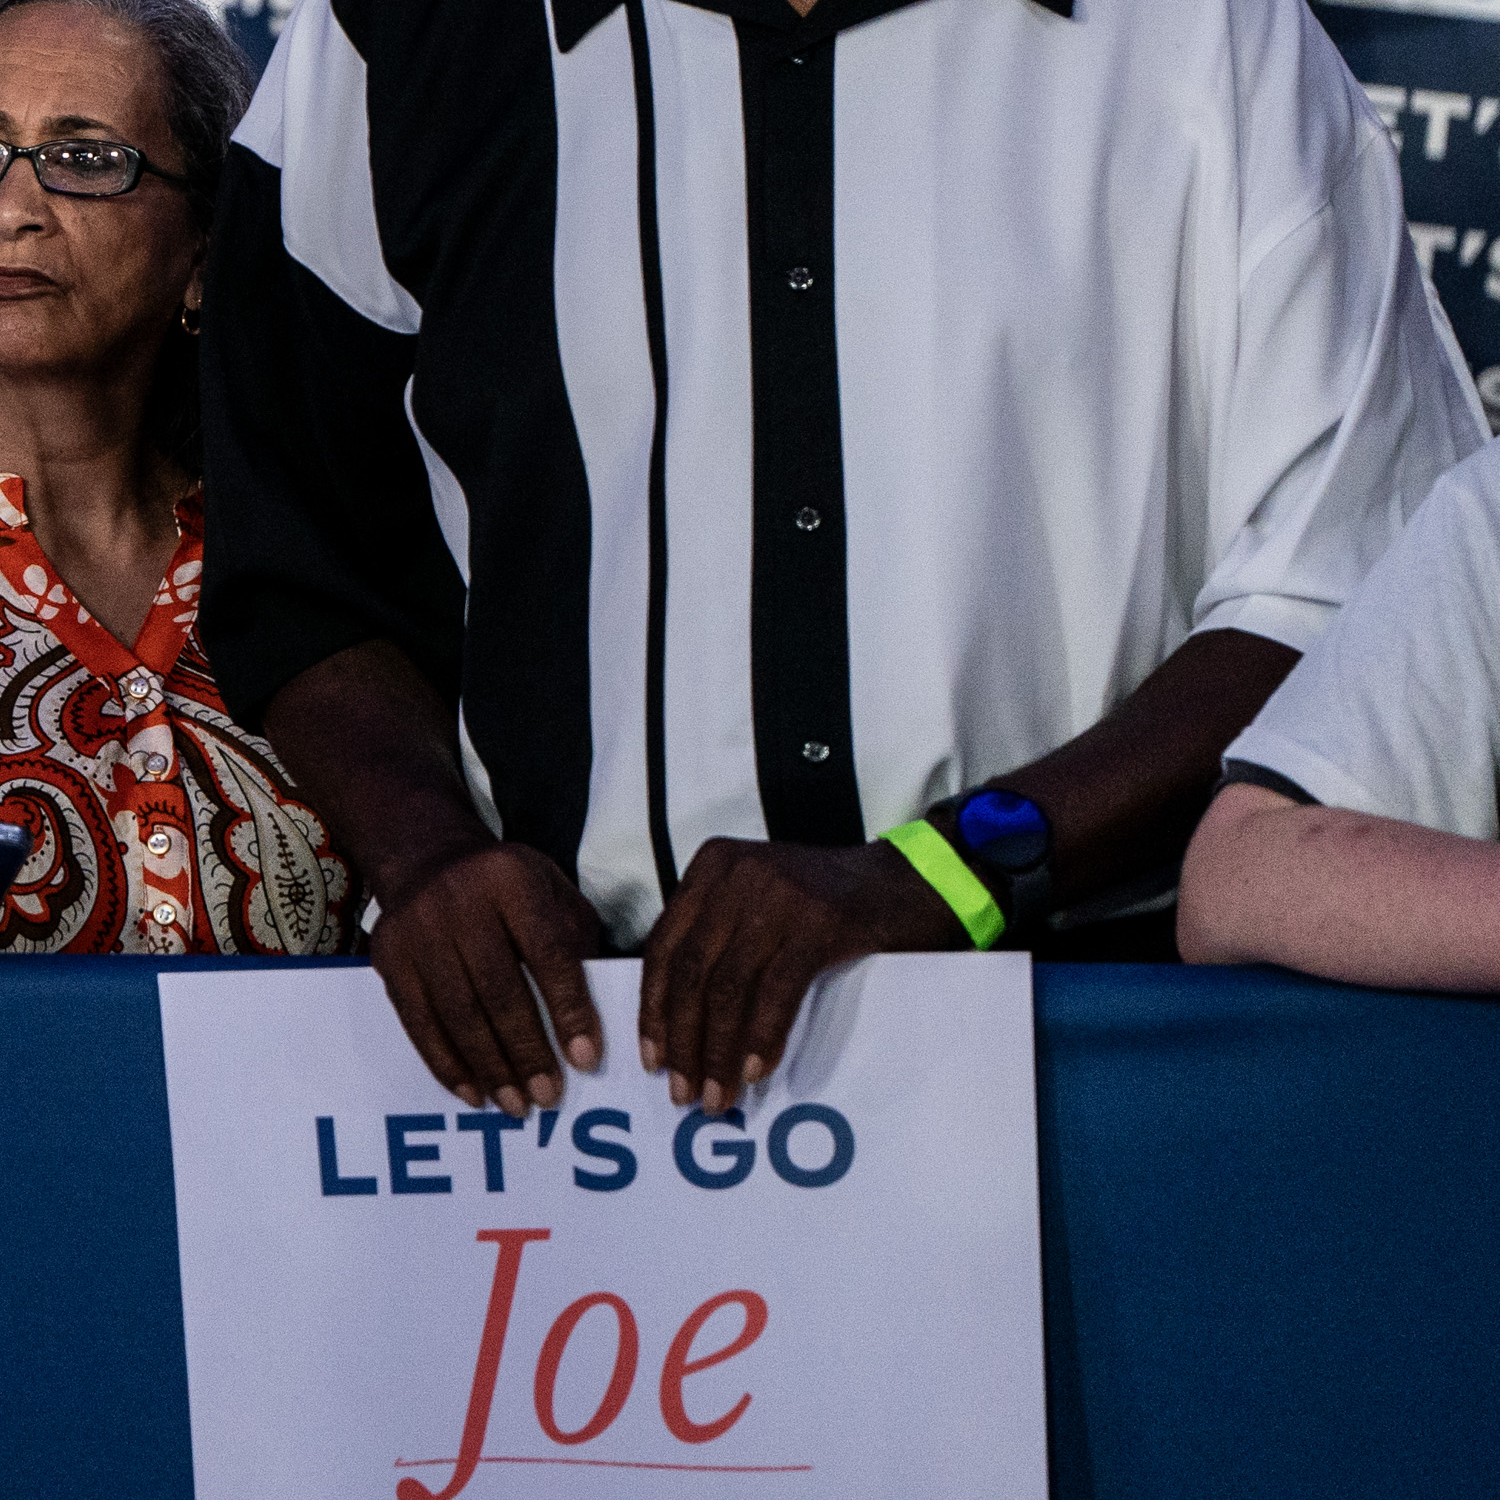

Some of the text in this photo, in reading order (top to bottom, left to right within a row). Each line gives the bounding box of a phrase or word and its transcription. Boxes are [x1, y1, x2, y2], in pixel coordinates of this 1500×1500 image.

[315, 1102, 857, 1197] LET'S GO
[395, 1228, 770, 1500] Joe
